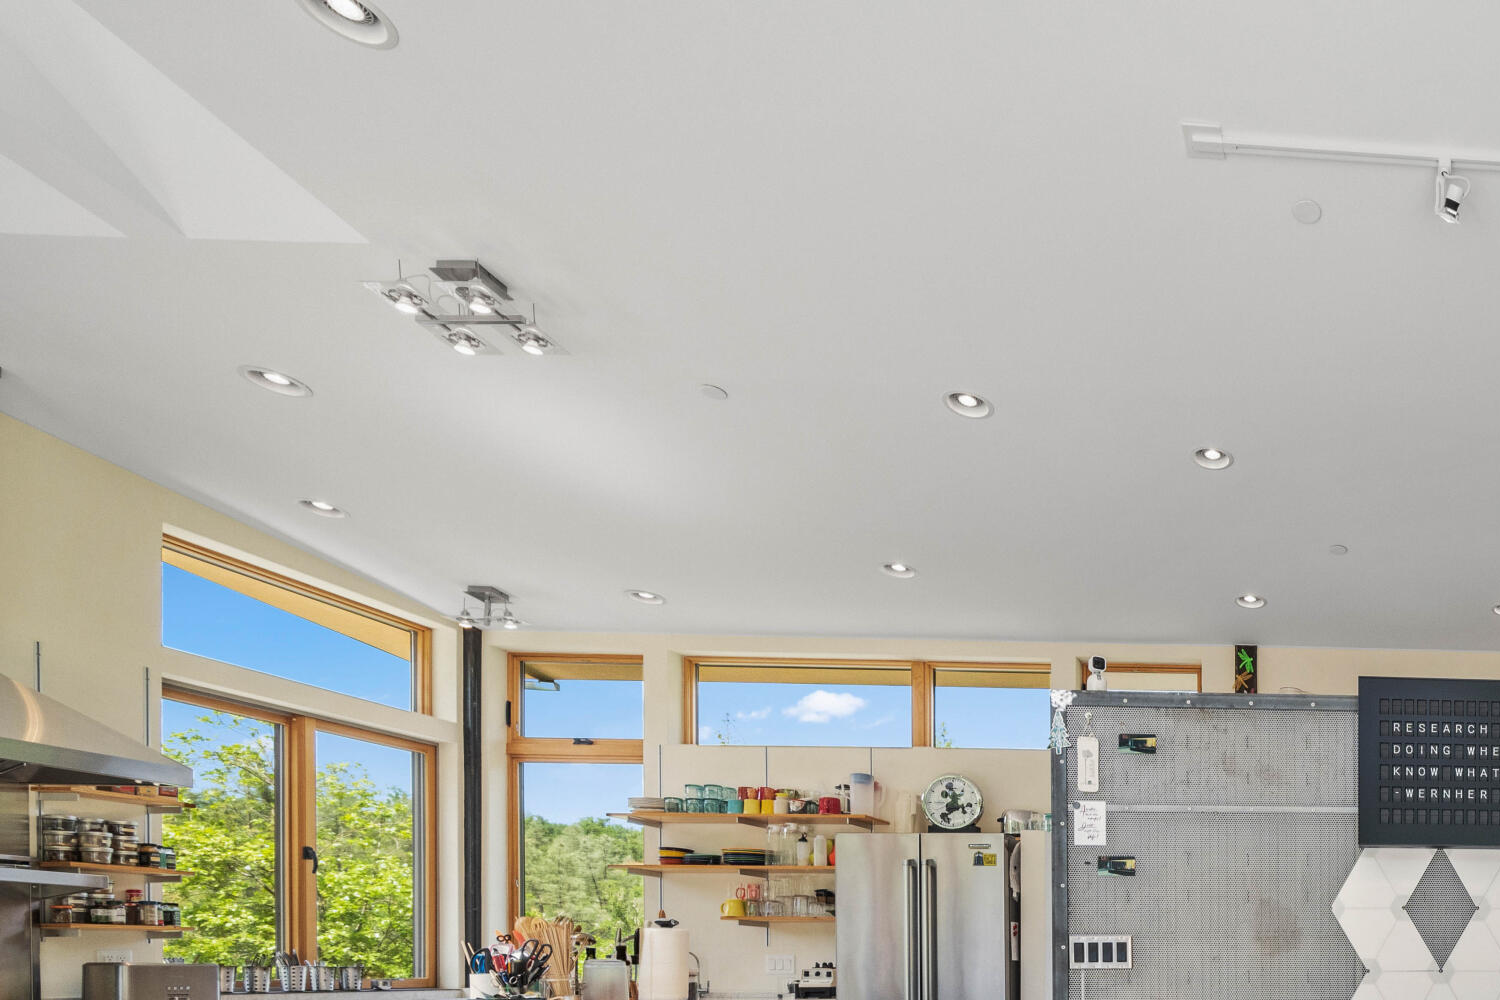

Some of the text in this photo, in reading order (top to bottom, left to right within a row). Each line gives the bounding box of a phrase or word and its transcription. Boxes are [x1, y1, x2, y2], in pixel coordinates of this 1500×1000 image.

[1393, 722, 1488, 734] RESEARCH
[1393, 744, 1451, 755] DOING
[1393, 766, 1439, 777] KNOW
[1454, 767, 1500, 778] WHAT
[1394, 788, 1488, 799] -WERNHER
